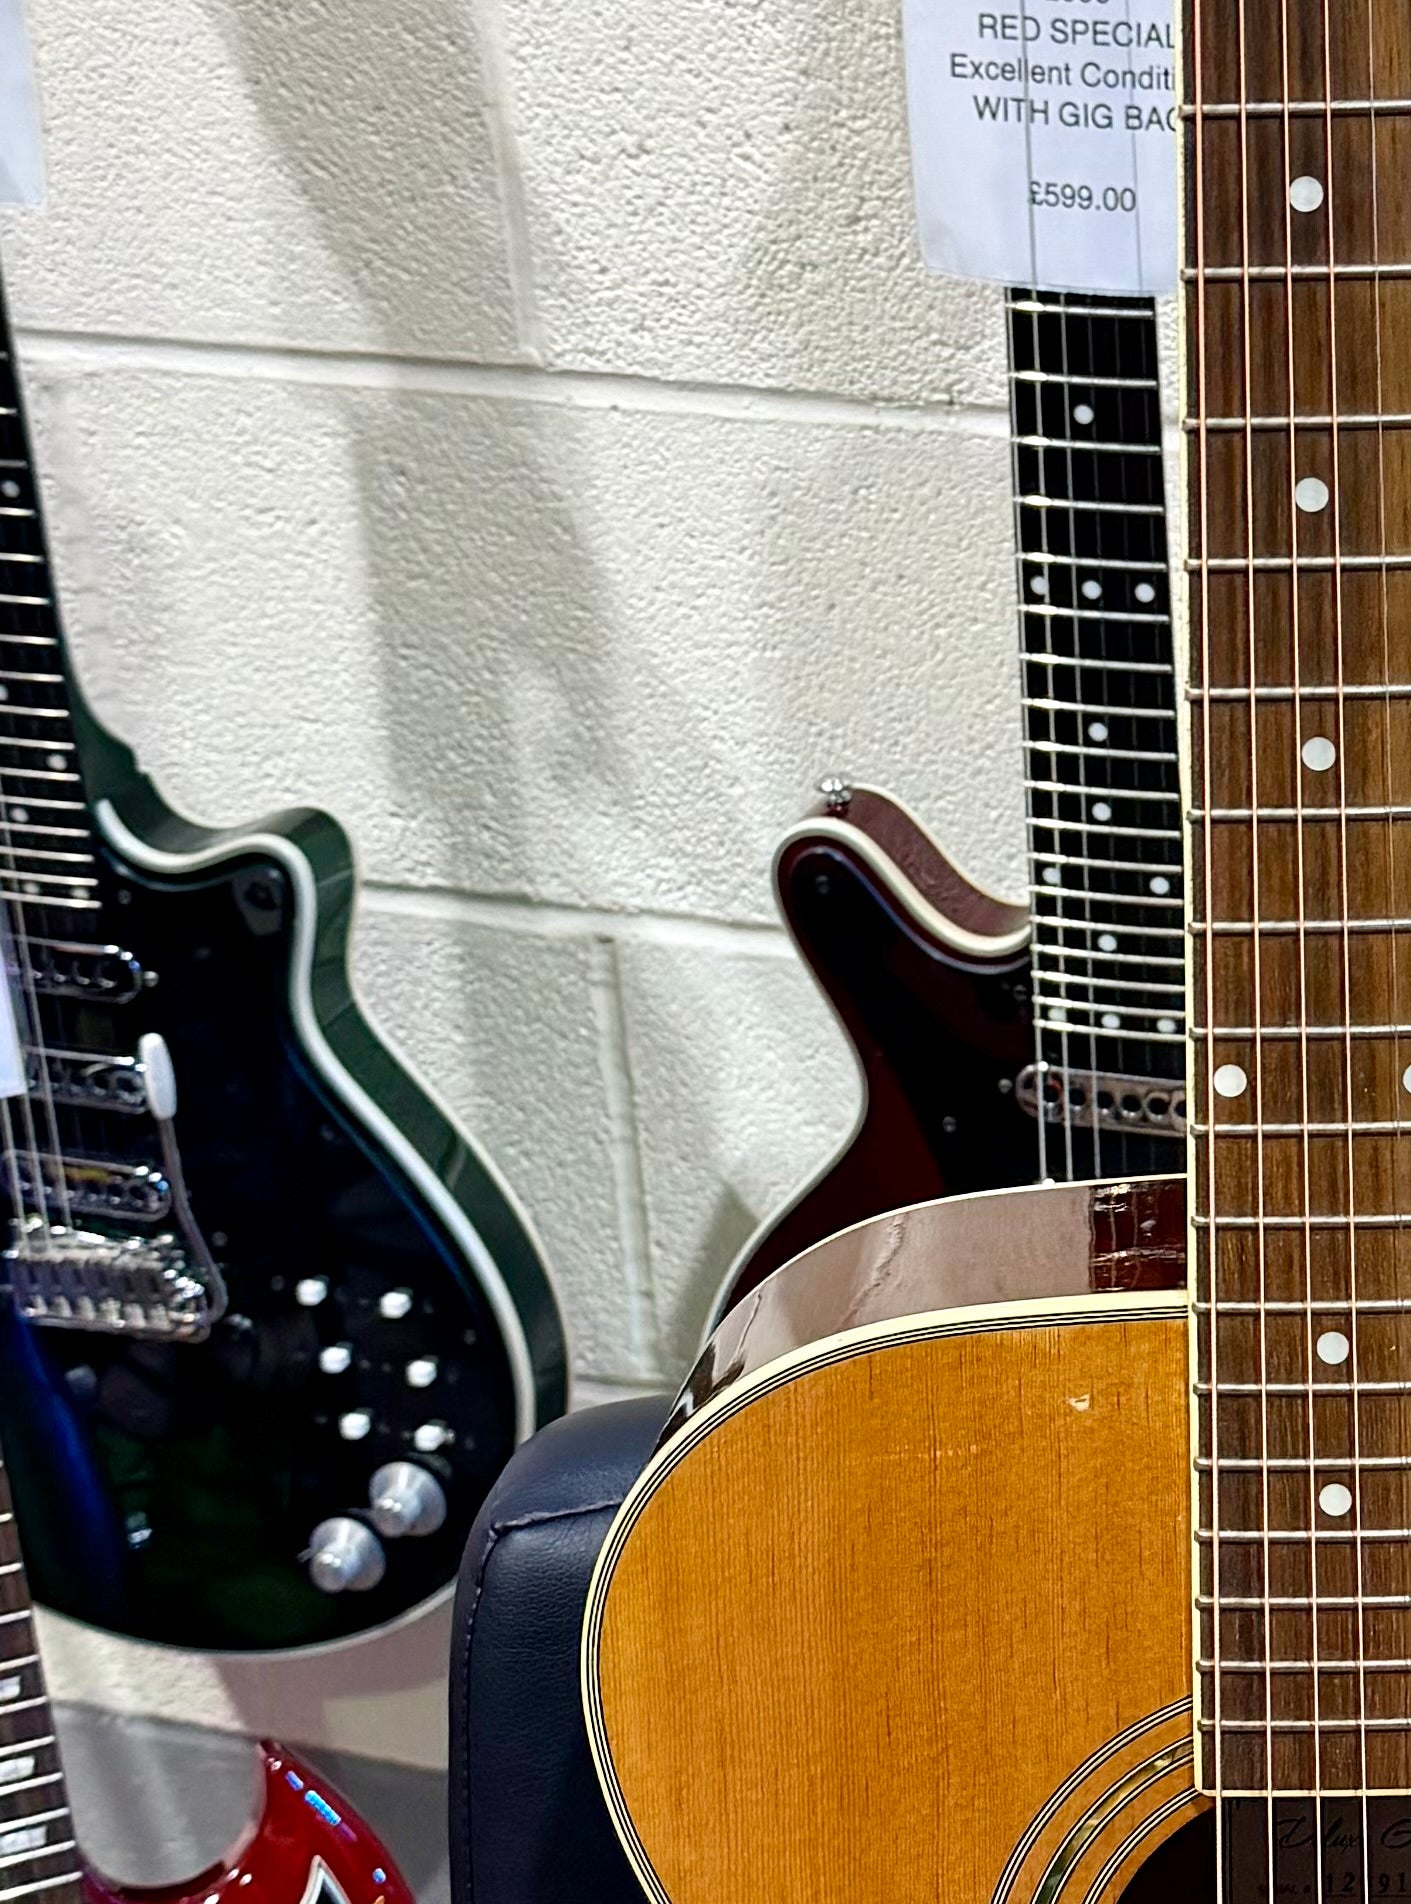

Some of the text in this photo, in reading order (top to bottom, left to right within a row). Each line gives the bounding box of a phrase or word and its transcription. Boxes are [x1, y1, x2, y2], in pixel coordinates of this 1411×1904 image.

[978, 12, 1175, 49] RED SPECIAL
[950, 52, 1175, 92] Excellent Conditi
[972, 94, 1050, 126] WITH
[1058, 100, 1114, 130] GIG
[1029, 180, 1137, 213] £599.00
